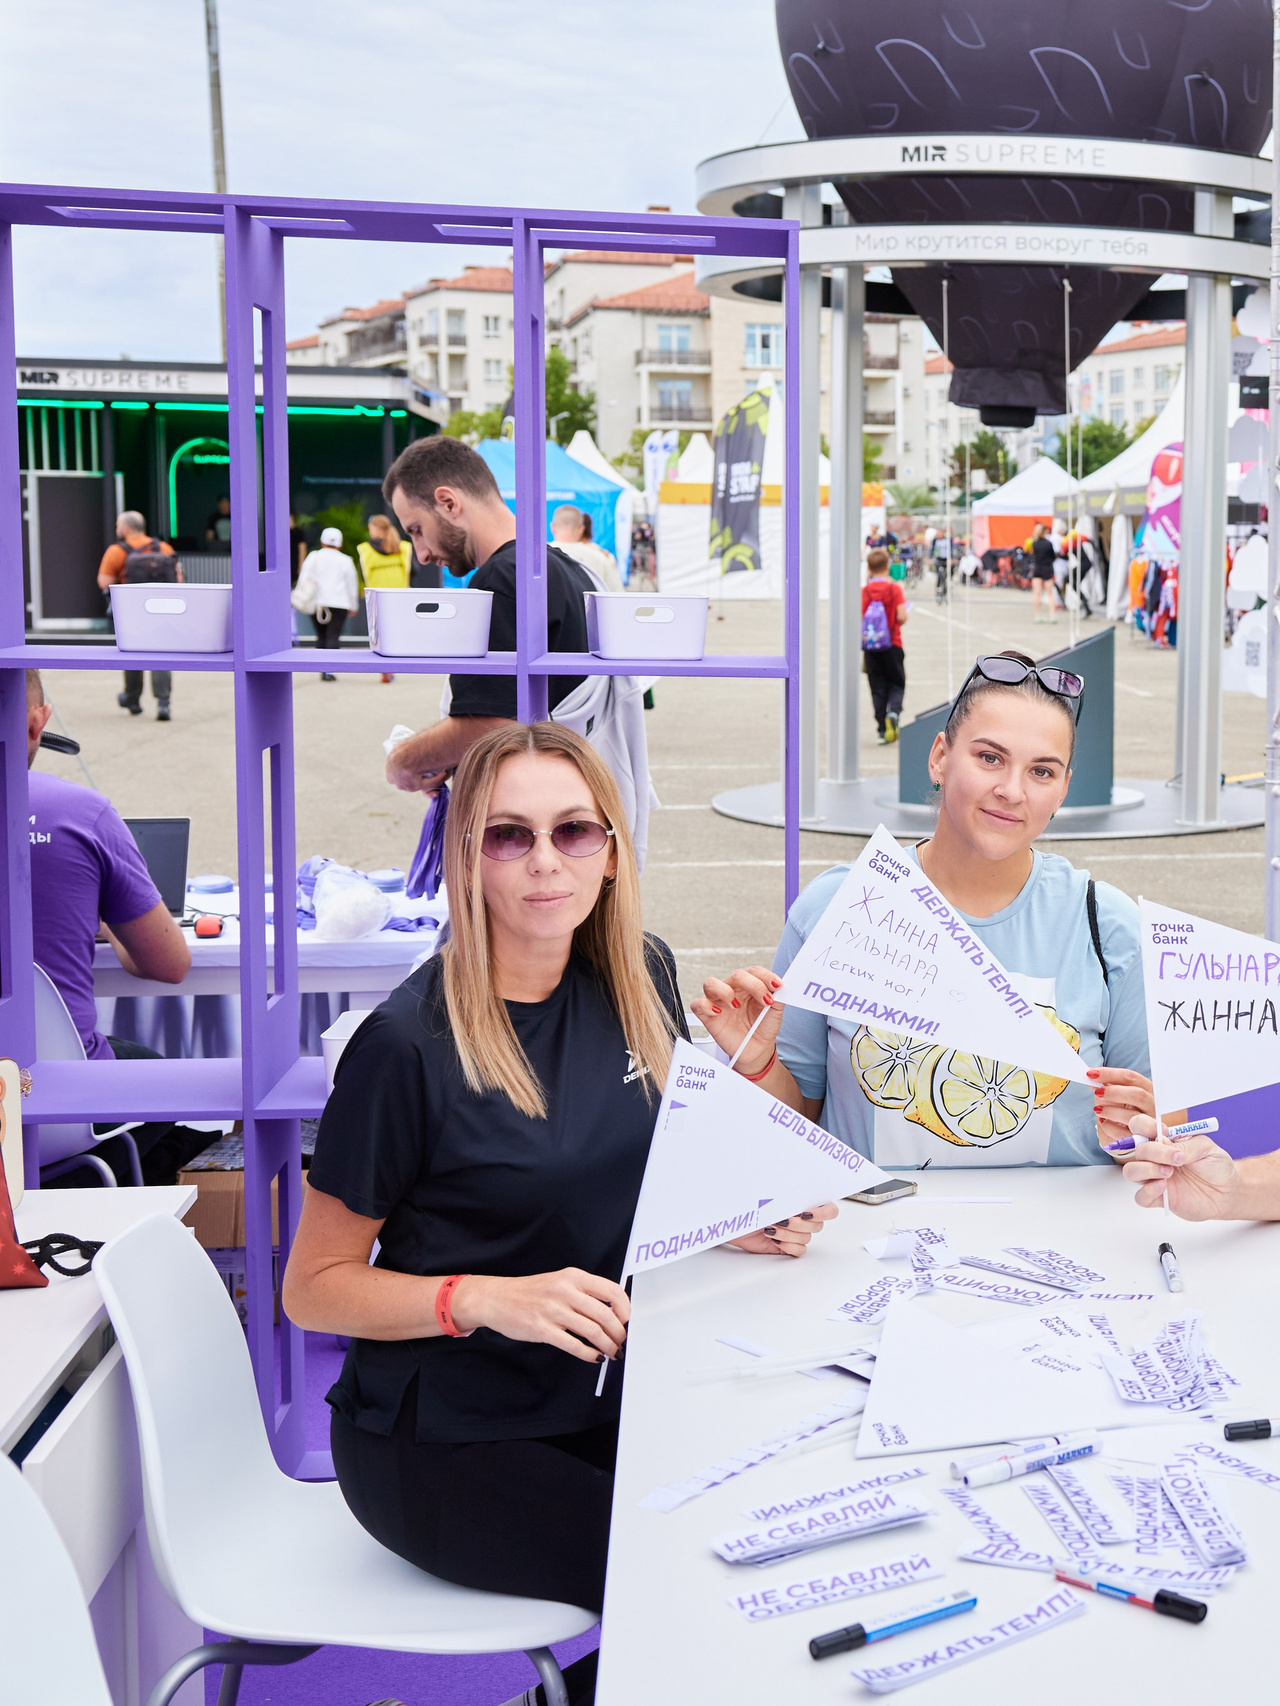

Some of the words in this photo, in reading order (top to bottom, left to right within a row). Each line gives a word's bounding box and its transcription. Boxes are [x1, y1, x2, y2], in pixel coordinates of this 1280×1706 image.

[901, 145, 947, 163] MIR
[956, 143, 1106, 167] SUPREME
[855, 233, 899, 254] Мир
[905, 234, 1007, 255] крутится
[1015, 234, 1093, 256] вокруг
[1099, 236, 1149, 257] тебя
[20, 371, 59, 385] MIR
[66, 371, 189, 391] SUPREME
[869, 857, 900, 884] банк
[874, 849, 911, 877] точка
[849, 886, 939, 954] ЖАННА
[1151, 921, 1195, 934] точка
[911, 884, 985, 967] ДЕРЖАТЬ
[981, 963, 1034, 1020] ТЕМП!
[1151, 932, 1189, 945] банк
[814, 946, 876, 983] Легких
[834, 920, 940, 985] ГУЛЬНАРА
[802, 981, 940, 1038] ПОДНАЖМИ!
[1158, 997, 1279, 1035] ЖАННА
[676, 1076, 707, 1092] банк
[679, 1064, 716, 1079] точка
[767, 1101, 807, 1138] ЦЕЛЬ
[805, 1127, 865, 1174] БЛИЗКО!
[1175, 1121, 1209, 1136] MARKER
[635, 1210, 755, 1264] ПОДНАЖМИ!
[840, 1275, 899, 1313] ОБОРОТЫ!
[935, 1273, 1058, 1303] ПОКОРИТЬ!
[1040, 1317, 1067, 1337] банк
[1051, 1315, 1082, 1338] точка
[1031, 1357, 1068, 1374] банк
[1041, 1354, 1083, 1372] точка
[873, 1422, 893, 1447] точка
[889, 1423, 909, 1446] банк
[1057, 1444, 1094, 1464] MARKER
[1184, 1442, 1280, 1484] БЛИЗКО!
[751, 1467, 925, 1522] ПОДНАЖМИ!
[723, 1533, 767, 1554] НЕ
[766, 1489, 897, 1539] СБАВЛЯЙ
[1136, 1477, 1159, 1555] ПОДНАЖМИ!
[1202, 1529, 1234, 1551] ЕЛЬ
[737, 1589, 780, 1611] НЕ
[785, 1553, 932, 1599] СБАВЛЯЙ
[1132, 1565, 1231, 1584] ТЕМП!
[863, 1633, 997, 1683] ДЕРЖАТЬ
[991, 1587, 1078, 1640] ТЕМП!
